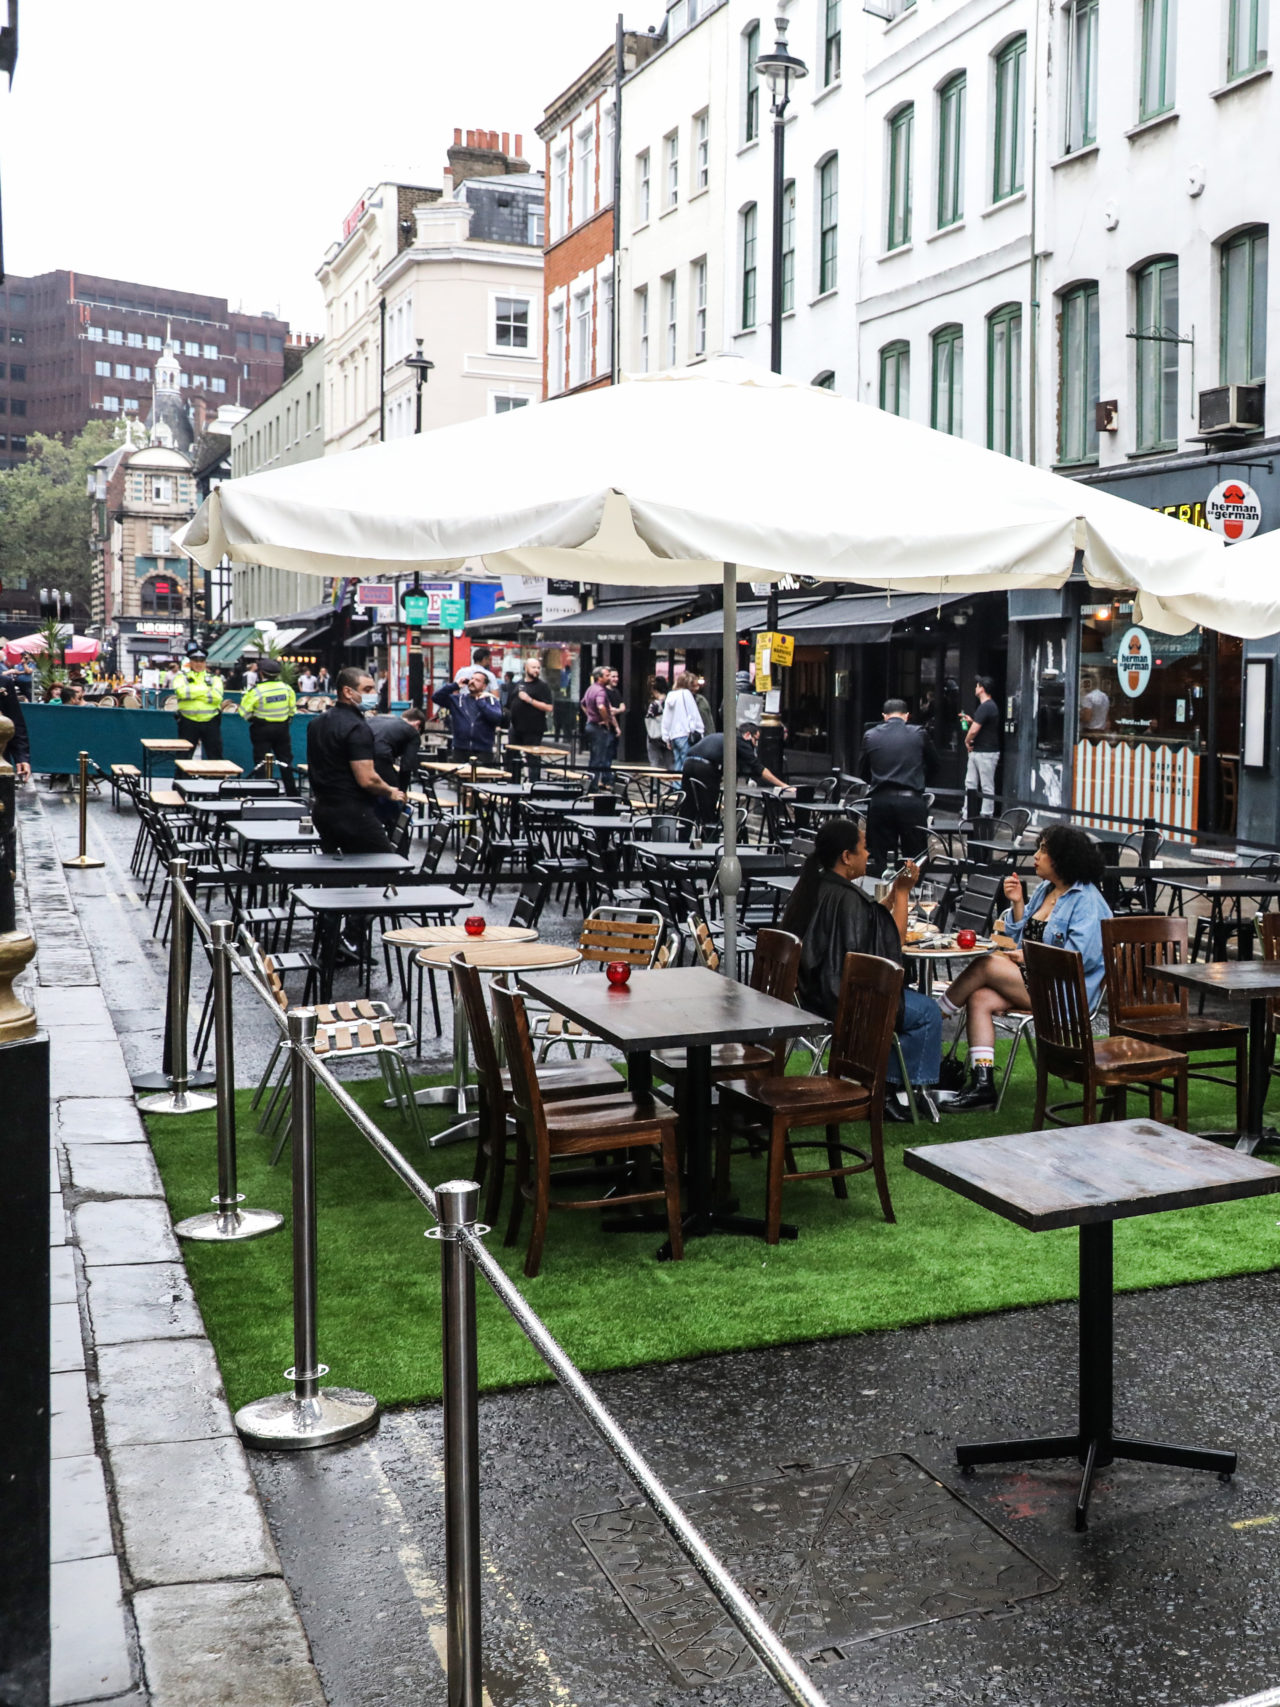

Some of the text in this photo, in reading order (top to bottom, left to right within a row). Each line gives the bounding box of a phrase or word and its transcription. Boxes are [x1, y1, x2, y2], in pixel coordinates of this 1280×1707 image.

[1211, 502, 1257, 513] herman
[1214, 511, 1259, 520] german
[1121, 654, 1148, 663] herman
[1123, 662, 1149, 671] german
